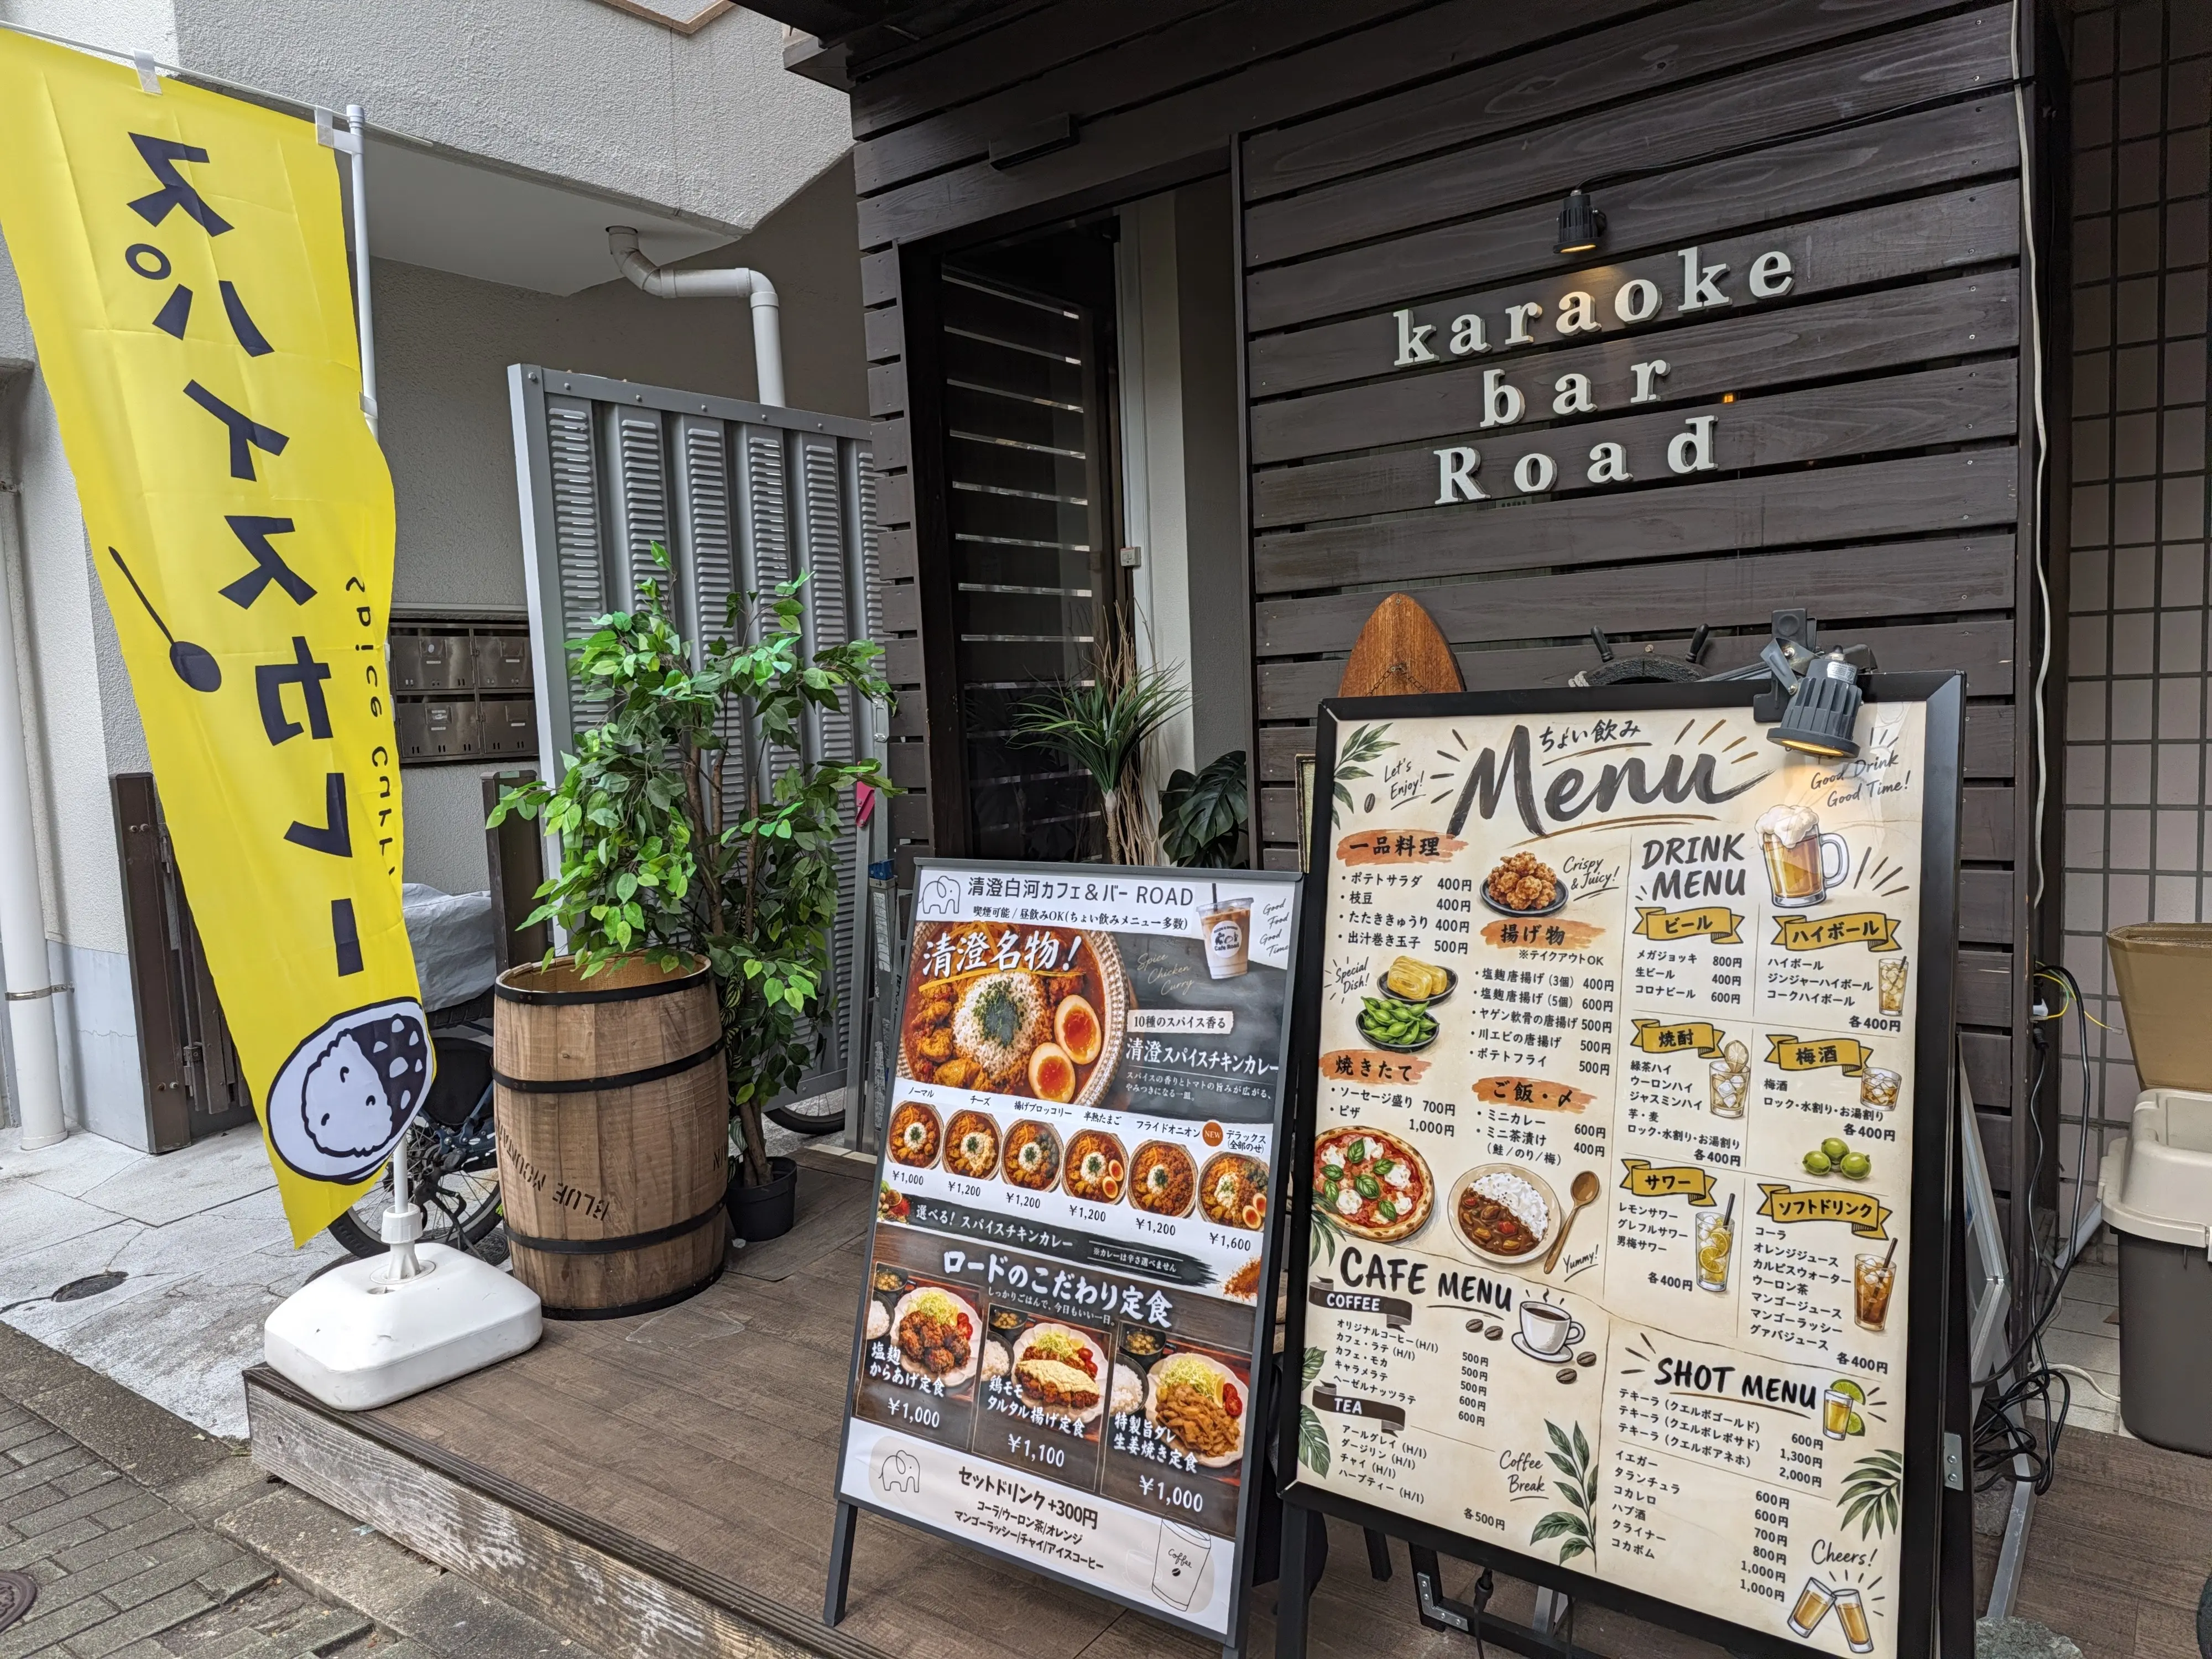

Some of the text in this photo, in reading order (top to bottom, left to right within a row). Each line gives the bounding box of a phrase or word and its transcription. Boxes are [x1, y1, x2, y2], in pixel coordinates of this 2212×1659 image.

[1393, 246, 1796, 368] karaoke
[1480, 359, 1671, 429] bar
[1433, 414, 1719, 505] Road
[1539, 719, 1641, 753] ちょい飲み
[1384, 758, 1412, 783] Let's
[1811, 750, 1899, 790] Good Drink
[1390, 770, 1424, 800] Enjoy!
[1447, 724, 1776, 839] Menu
[1827, 770, 1911, 807] Good Time!
[1349, 835, 1440, 857] 一品料理
[1642, 833, 1746, 870] DRINK
[1563, 856, 1604, 874] Crispy
[1351, 872, 1472, 892] ポテトサラダ 400円
[1571, 865, 1620, 890] & Juicy!
[1652, 869, 1747, 901] MENU
[1136, 886, 1193, 906] ROAD
[1349, 891, 1373, 905] 枝豆
[973, 906, 1010, 919] 喫煙可能
[1263, 898, 1286, 915] Good
[1267, 912, 1290, 929] Food
[1349, 910, 1427, 930] たたききゅうり
[1665, 915, 1713, 934] ビール
[1260, 928, 1282, 946] Good
[1500, 924, 1566, 946] 揚げ物
[1792, 920, 1879, 943] ハイボール
[1348, 931, 1468, 954] 出汁巻き玉子 500円
[922, 930, 1082, 978] 清澄名物!
[1137, 952, 1168, 972] Spice
[1519, 950, 1604, 966] ※テイクアウトOK
[1637, 950, 1742, 968] メガジョッキ 800円
[1768, 958, 1824, 970] ハイボール
[1147, 964, 1191, 984] Chicken
[1335, 956, 1369, 984] Special
[1635, 967, 1675, 979] 生ビール
[1161, 978, 1194, 996] Curry
[1343, 973, 1369, 994] Dish!
[1635, 985, 1695, 999] コロナビール
[1768, 973, 1874, 992] ジンジャーハイボール
[1582, 998, 1613, 1013] 600円
[1767, 990, 1855, 1006] コークハイボール
[1134, 1015, 1226, 1029] 10種のスパイス香る
[1480, 1008, 1578, 1029] ヤゲン軟骨の唐揚げ
[1849, 1015, 1901, 1032] 各400円
[1478, 1028, 1562, 1048] 川エビの唐揚げ
[1658, 1029, 1694, 1048] 焼酎
[1126, 1037, 1279, 1076] 清澄スパイスチキンカレー
[1478, 1047, 1547, 1067] ポテトフライ
[1796, 1045, 1838, 1066] 梅酒
[1334, 1055, 1412, 1082] 焼きたて
[1630, 1060, 1672, 1075] 緑茶ハイ
[908, 1086, 935, 1098] ノーマル
[1125, 1084, 1194, 1102] やみつきになる一皿。
[1126, 1072, 1271, 1100] スパイスの香りとトマトの旨みが広がる、
[1630, 1076, 1693, 1093] ウーロンハイ
[1764, 1078, 1787, 1092] 梅酒
[970, 1095, 992, 1106] チーズ
[1014, 1100, 1072, 1117] 揚げブロッコリー
[1341, 1087, 1455, 1117] ソーセージ盛り 700円
[1630, 1091, 1702, 1110] ジャスミンハイ
[1764, 1097, 1884, 1122] ロック・水割り・お湯割り
[1083, 1110, 1122, 1125] 半熟たまご
[1339, 1105, 1454, 1137] ピザ 1,000円
[1488, 1109, 1546, 1126] ミニカレー
[1628, 1108, 1659, 1123] 芋・麦
[1136, 1120, 1200, 1138] フライドオニオン
[1204, 1130, 1220, 1139] NEW
[1226, 1130, 1266, 1144] デラックス
[1486, 1126, 1547, 1146] ミニ茶漬け
[1627, 1124, 1740, 1150] ロック・水割り・お湯割り
[1843, 1123, 1896, 1142] 各400円
[1228, 1139, 1264, 1154] (全部のせ)
[1693, 1149, 1741, 1167] 各400円
[892, 1170, 924, 1186] ¥1,000
[1645, 1175, 1691, 1190] サワー
[948, 1181, 980, 1197] ¥1,200
[552, 1182, 610, 1221] BLUE
[1005, 1192, 1041, 1208] ¥1,200
[1778, 1199, 1872, 1218] ソフトドリンク
[1069, 1204, 1106, 1222] ¥1,200
[1619, 1202, 1678, 1220] レモンサワー
[961, 1216, 1073, 1248] スパイスチキンカレー
[1135, 1217, 1176, 1236] ¥1,200
[1618, 1218, 1688, 1239] グレフルサワー
[1755, 1227, 1786, 1240] コーラ
[1209, 1232, 1251, 1251] ¥1,600
[1616, 1235, 1667, 1252] 男梅サワー
[1093, 1247, 1177, 1272] ※カレーは辛さ選べません
[1563, 1244, 1599, 1274] Yummy!
[1754, 1243, 1839, 1267] オレンジジュース
[1340, 1246, 1512, 1312] CAFE MENU
[1648, 1271, 1693, 1292] 各400円
[1753, 1259, 1851, 1284] カルピスウォーター
[943, 1250, 1173, 1328] ロードのこだわり定食
[1752, 1275, 1809, 1295] ウーロン茶
[1327, 1293, 1380, 1311] COFFEE
[1751, 1291, 1842, 1319] マンゴージュース
[1751, 1308, 1843, 1333] マンゴーラッシー
[1750, 1324, 1829, 1350] グァバジュース
[872, 1342, 901, 1366] 塩麹
[1335, 1345, 1388, 1368] カフェ・モカ
[1837, 1352, 1888, 1374] 各400円
[869, 1363, 945, 1398] からあげ定食
[1334, 1359, 1388, 1382] キャラメラテ
[988, 1375, 1023, 1399] 鶏モモ
[1333, 1375, 1416, 1405] ヘーゼルナッツラテ
[1653, 1357, 1817, 1410] SHOT MENU
[887, 1397, 940, 1428] ¥1,000
[987, 1395, 1085, 1438] タルタル揚げ定食
[1334, 1397, 1363, 1416] TEA
[1114, 1411, 1176, 1444] 特製旨ダレ
[1008, 1433, 1065, 1468] ¥1,100
[1113, 1434, 1198, 1474] 生姜焼き定食
[1499, 1450, 1543, 1470] Coffee
[1615, 1450, 1658, 1468] イエガー
[1780, 1448, 1823, 1469] 1,300円
[1508, 1475, 1546, 1494] Break
[1614, 1467, 1681, 1495] タランチュラ
[1779, 1467, 1822, 1488] 2,000円
[958, 1466, 1098, 1530] セットドリンク +300円
[1139, 1475, 1203, 1512] ¥1,000
[1613, 1485, 1656, 1505] コカレロ
[1464, 1507, 1505, 1531] 各500円
[1612, 1503, 1646, 1521] ハブ酒
[977, 1501, 1083, 1545] コーラ/ウーロン茶/オレンジ
[1612, 1519, 1666, 1542] クライナー
[1168, 1548, 1192, 1568] Coffee
[1611, 1538, 1655, 1559] コカボム
[1811, 1538, 1879, 1567] Cheers!
